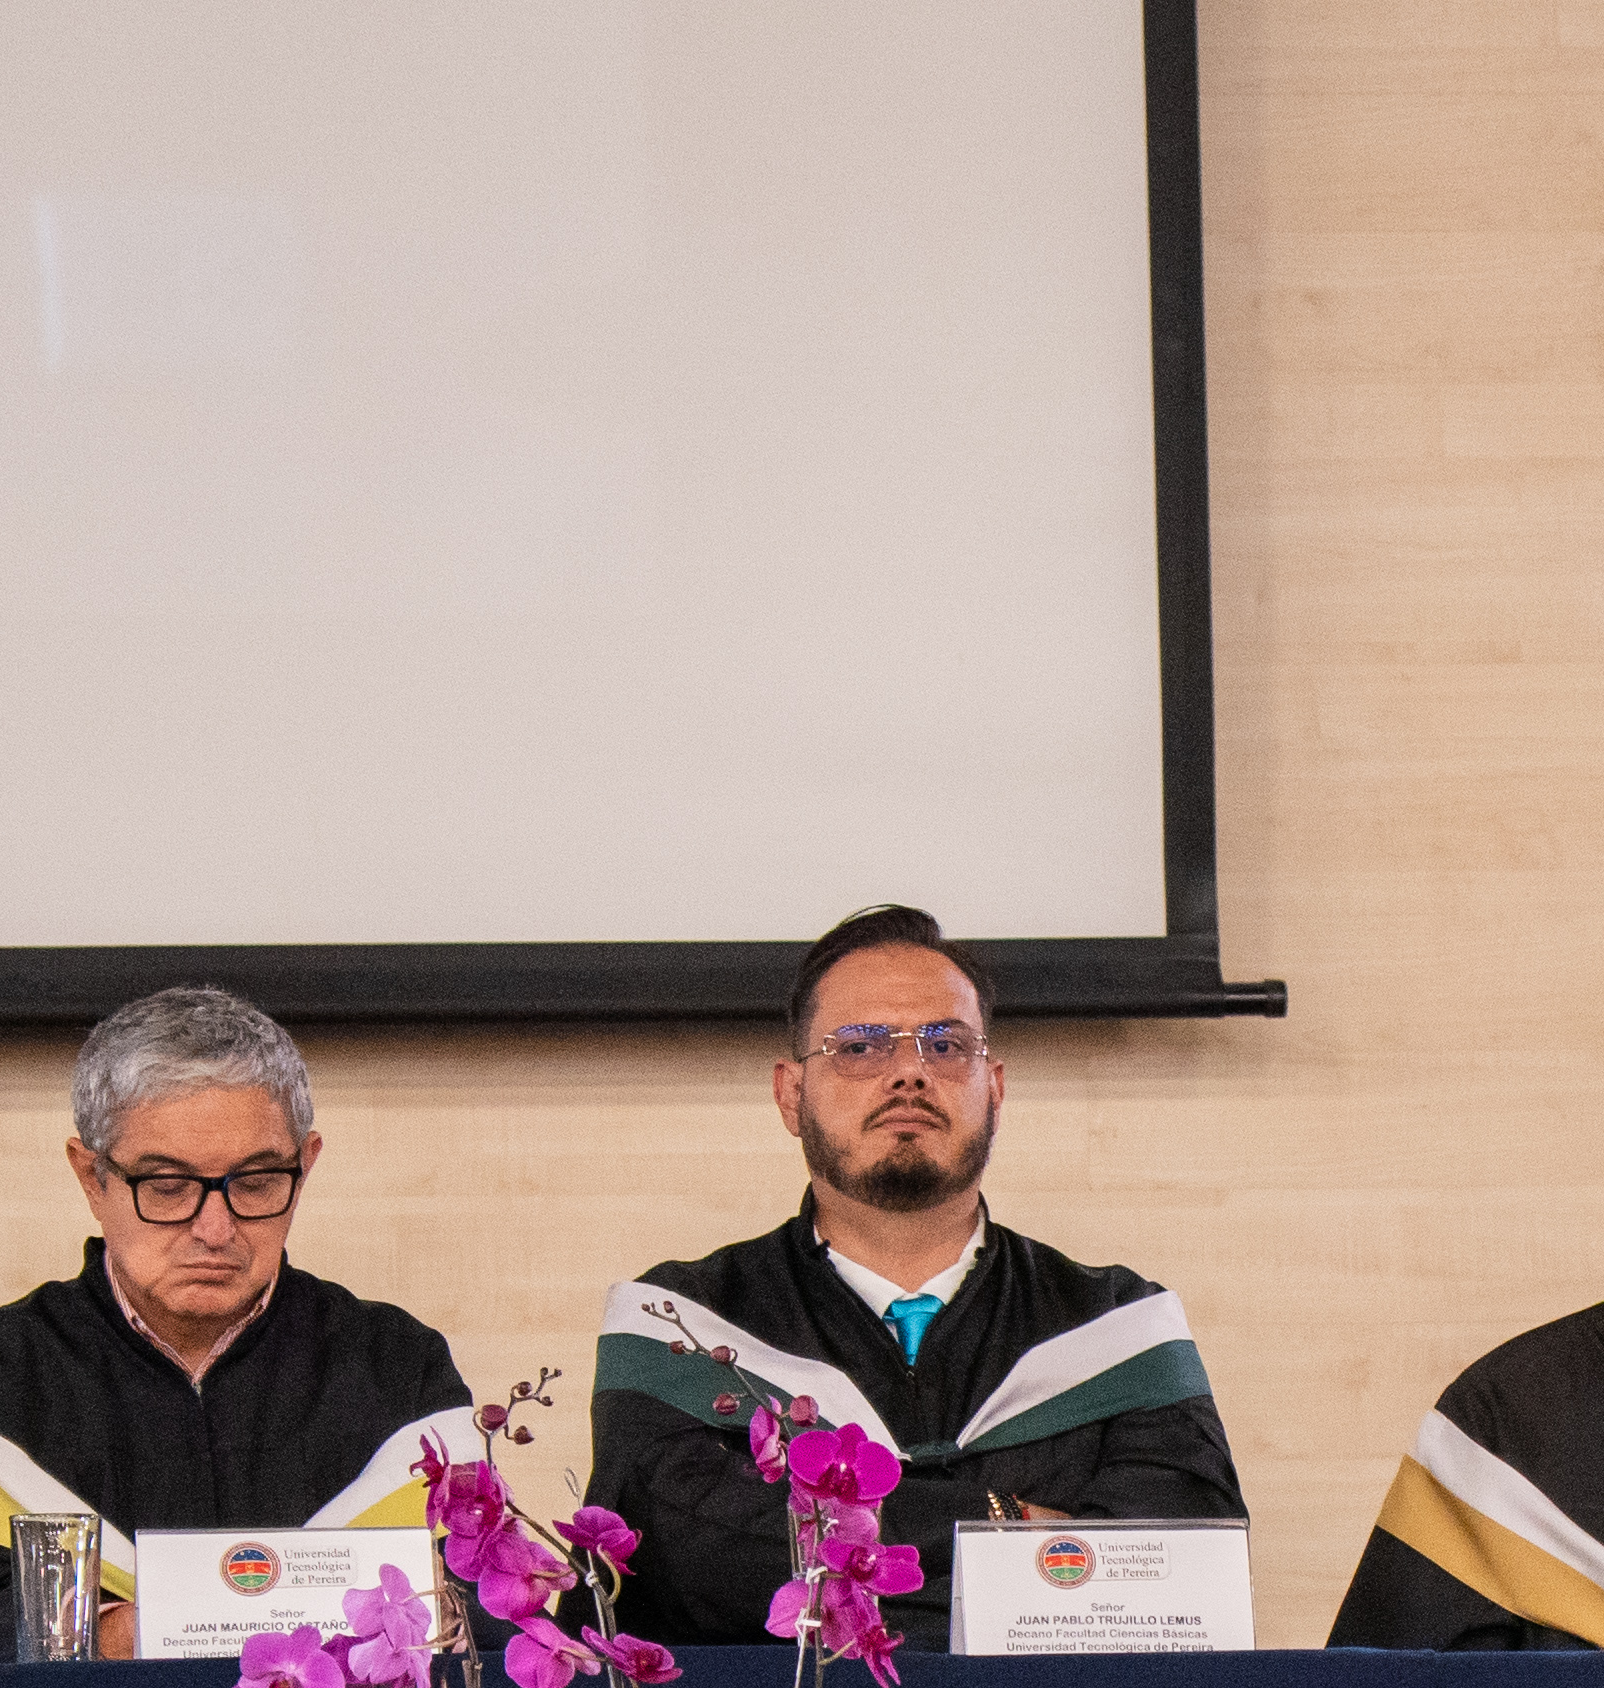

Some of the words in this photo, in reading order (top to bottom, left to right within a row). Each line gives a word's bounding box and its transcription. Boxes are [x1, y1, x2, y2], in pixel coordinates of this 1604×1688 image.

[1098, 1541, 1164, 1552] Universidad
[283, 1548, 351, 1559] Universidad
[1100, 1555, 1165, 1567] Tecnológica
[284, 1561, 351, 1573] Tecnológica
[1106, 1568, 1119, 1578] de
[1122, 1568, 1160, 1578] Pereira
[291, 1575, 305, 1585] de
[308, 1574, 347, 1584] Pereira
[1090, 1602, 1126, 1612] Señor
[270, 1609, 307, 1619] Señor
[1015, 1615, 1050, 1625] JUAN
[1053, 1615, 1094, 1625] PABLO
[1098, 1615, 1157, 1625] TRUJILLO
[1160, 1615, 1202, 1626] LEMUS
[182, 1623, 217, 1634] JUAN
[220, 1622, 285, 1633] MAURICIO
[1008, 1629, 1053, 1639] Decano
[1056, 1629, 1106, 1638] Facultad
[1109, 1629, 1159, 1638] Ciencias
[1162, 1629, 1208, 1639] Básicas
[163, 1637, 209, 1647] Decano
[211, 1636, 246, 1646] Facul
[1006, 1642, 1077, 1652] Universidad
[1153, 1642, 1169, 1651] de
[1171, 1642, 1214, 1652] Pereira
[183, 1649, 240, 1659] Universid
